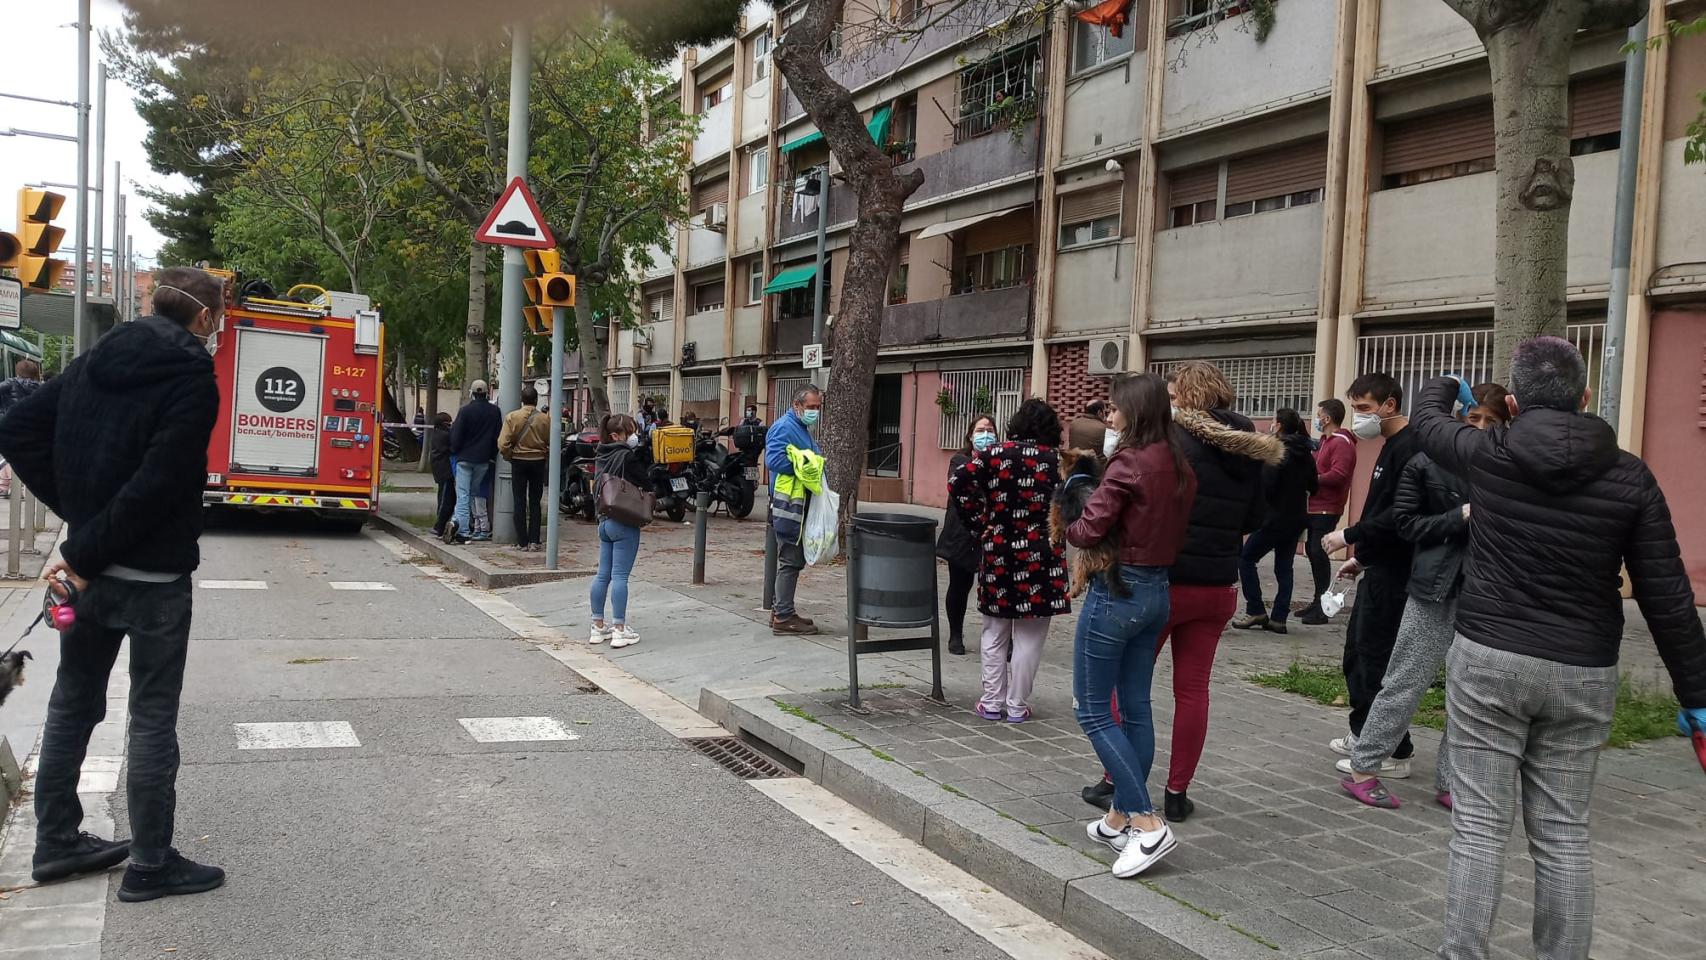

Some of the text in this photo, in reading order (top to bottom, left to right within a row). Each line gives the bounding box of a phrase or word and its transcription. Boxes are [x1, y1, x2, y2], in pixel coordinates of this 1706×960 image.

[333, 366, 366, 377] B-127
[264, 378, 297, 396] 112
[238, 414, 316, 432] BOMBERS
[237, 427, 315, 440] bcn.cat/bombers
[666, 446, 690, 455] Glovo
